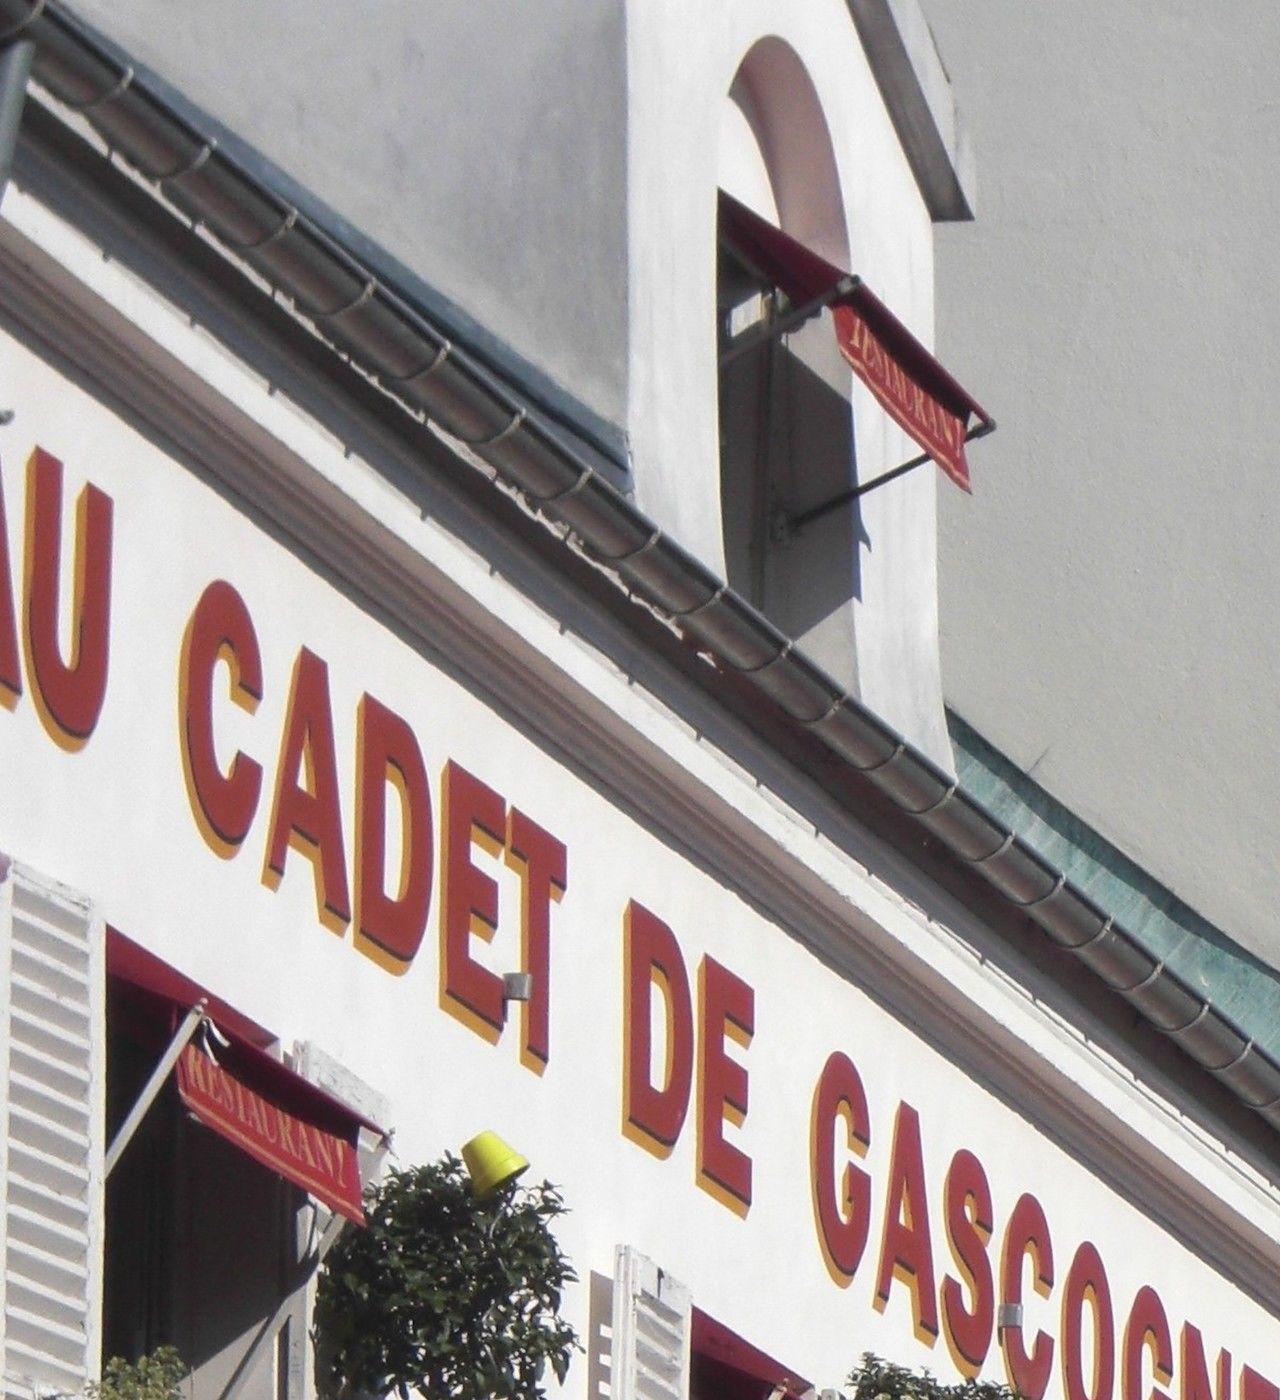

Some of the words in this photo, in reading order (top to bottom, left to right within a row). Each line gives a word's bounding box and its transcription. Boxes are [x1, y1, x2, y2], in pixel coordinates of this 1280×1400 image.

[178, 578, 568, 1078] CADET
[622, 896, 755, 1221] DE
[184, 1044, 351, 1189] RESTAURANT
